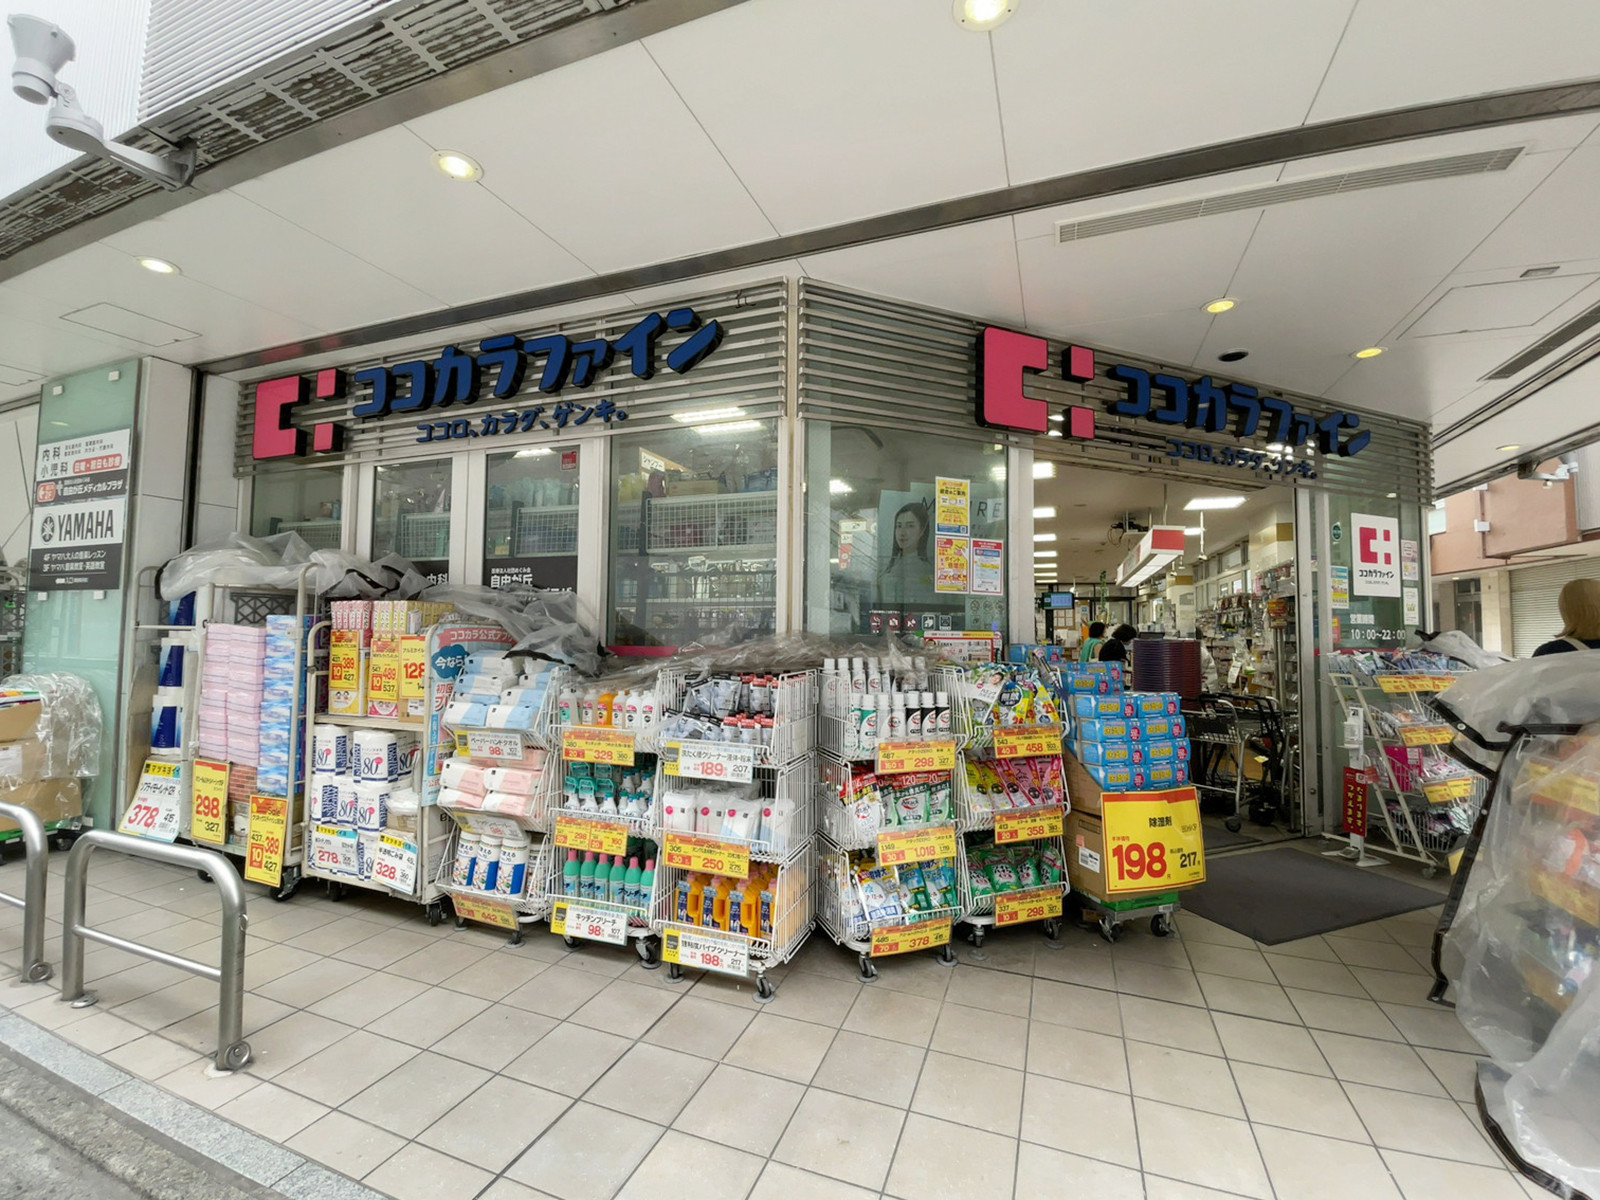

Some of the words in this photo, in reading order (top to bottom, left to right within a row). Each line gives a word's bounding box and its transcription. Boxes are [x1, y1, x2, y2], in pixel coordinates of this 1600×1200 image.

[353, 307, 724, 418] ココカラファイン
[1107, 363, 1371, 457] ココカラファイン
[416, 400, 628, 443] ココロ、カラダ、ゲンキ。
[42, 446, 61, 462] 内科
[41, 461, 69, 478] 小児科
[58, 509, 114, 541] YAMAHA
[1359, 569, 1394, 579] ココカラファイン
[491, 574, 533, 589] 自由が丘
[383, 684, 395, 692] 537
[489, 746, 501, 755] 98
[1025, 743, 1043, 752] 458
[594, 749, 613, 760] 328
[362, 757, 379, 775] 80
[700, 761, 724, 776] 189
[733, 765, 748, 773] 207
[914, 757, 934, 768] 298
[902, 775, 916, 785] 120
[195, 794, 220, 819] 298
[127, 804, 160, 828] 378
[1149, 816, 1172, 828] 除湿剤
[204, 821, 220, 832] 327
[1027, 825, 1045, 837] 358
[265, 836, 280, 855] 389
[318, 850, 339, 864] 278
[702, 857, 724, 870] 250
[1112, 842, 1167, 880] 198
[1180, 852, 1197, 868] 217
[264, 860, 278, 872] 427
[376, 861, 397, 880] 328
[1027, 906, 1045, 918] 298
[576, 913, 617, 926] キッチンブリーチ
[588, 924, 601, 936] 98
[909, 936, 930, 948] 378
[700, 953, 720, 966] 198
